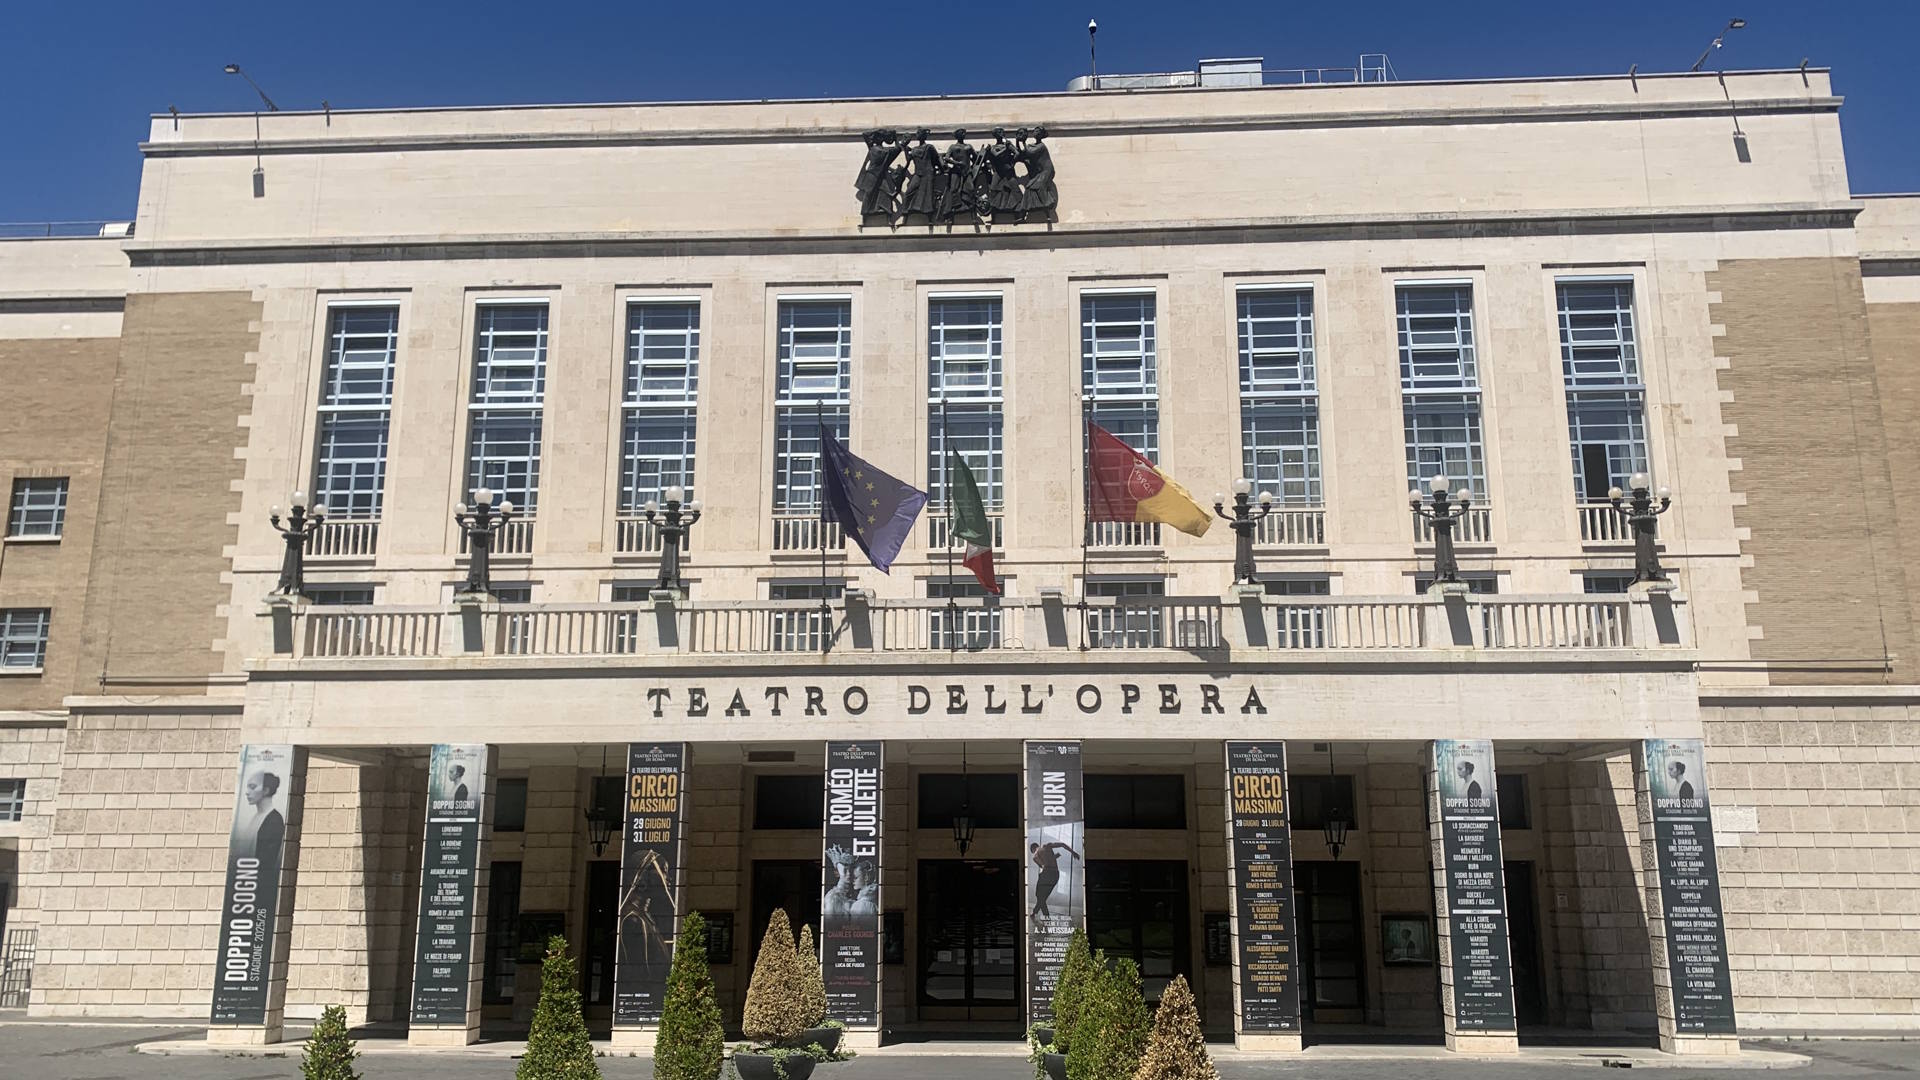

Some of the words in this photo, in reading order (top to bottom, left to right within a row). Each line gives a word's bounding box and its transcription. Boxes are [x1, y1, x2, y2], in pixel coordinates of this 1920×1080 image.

[646, 685, 869, 718] TEATRO
[631, 775, 677, 798] CIRCO
[827, 769, 853, 824] ROMÉO
[1043, 772, 1066, 816] BURN
[1234, 775, 1282, 798] CIRCO
[433, 800, 454, 810] DOPPIO
[455, 800, 474, 810] SOGNO
[630, 799, 677, 813] MASSIMO
[854, 768, 876, 836] JULIETTE
[1235, 799, 1283, 814] MASSIMO
[1446, 799, 1468, 807] DOPPIO
[1470, 799, 1490, 807] SOGNO
[1657, 799, 1680, 808] DOPPIO
[1682, 799, 1704, 808] SOGNO
[633, 818, 644, 829] 29
[645, 818, 671, 829] GIUGNO
[633, 832, 643, 842] 31
[644, 832, 670, 842] LUGLIO
[853, 838, 875, 856] ET
[232, 858, 260, 914] SOGNO
[255, 908, 266, 942] 2025/26
[224, 919, 254, 982] DOPPIO
[250, 944, 264, 982] STAGIONE
